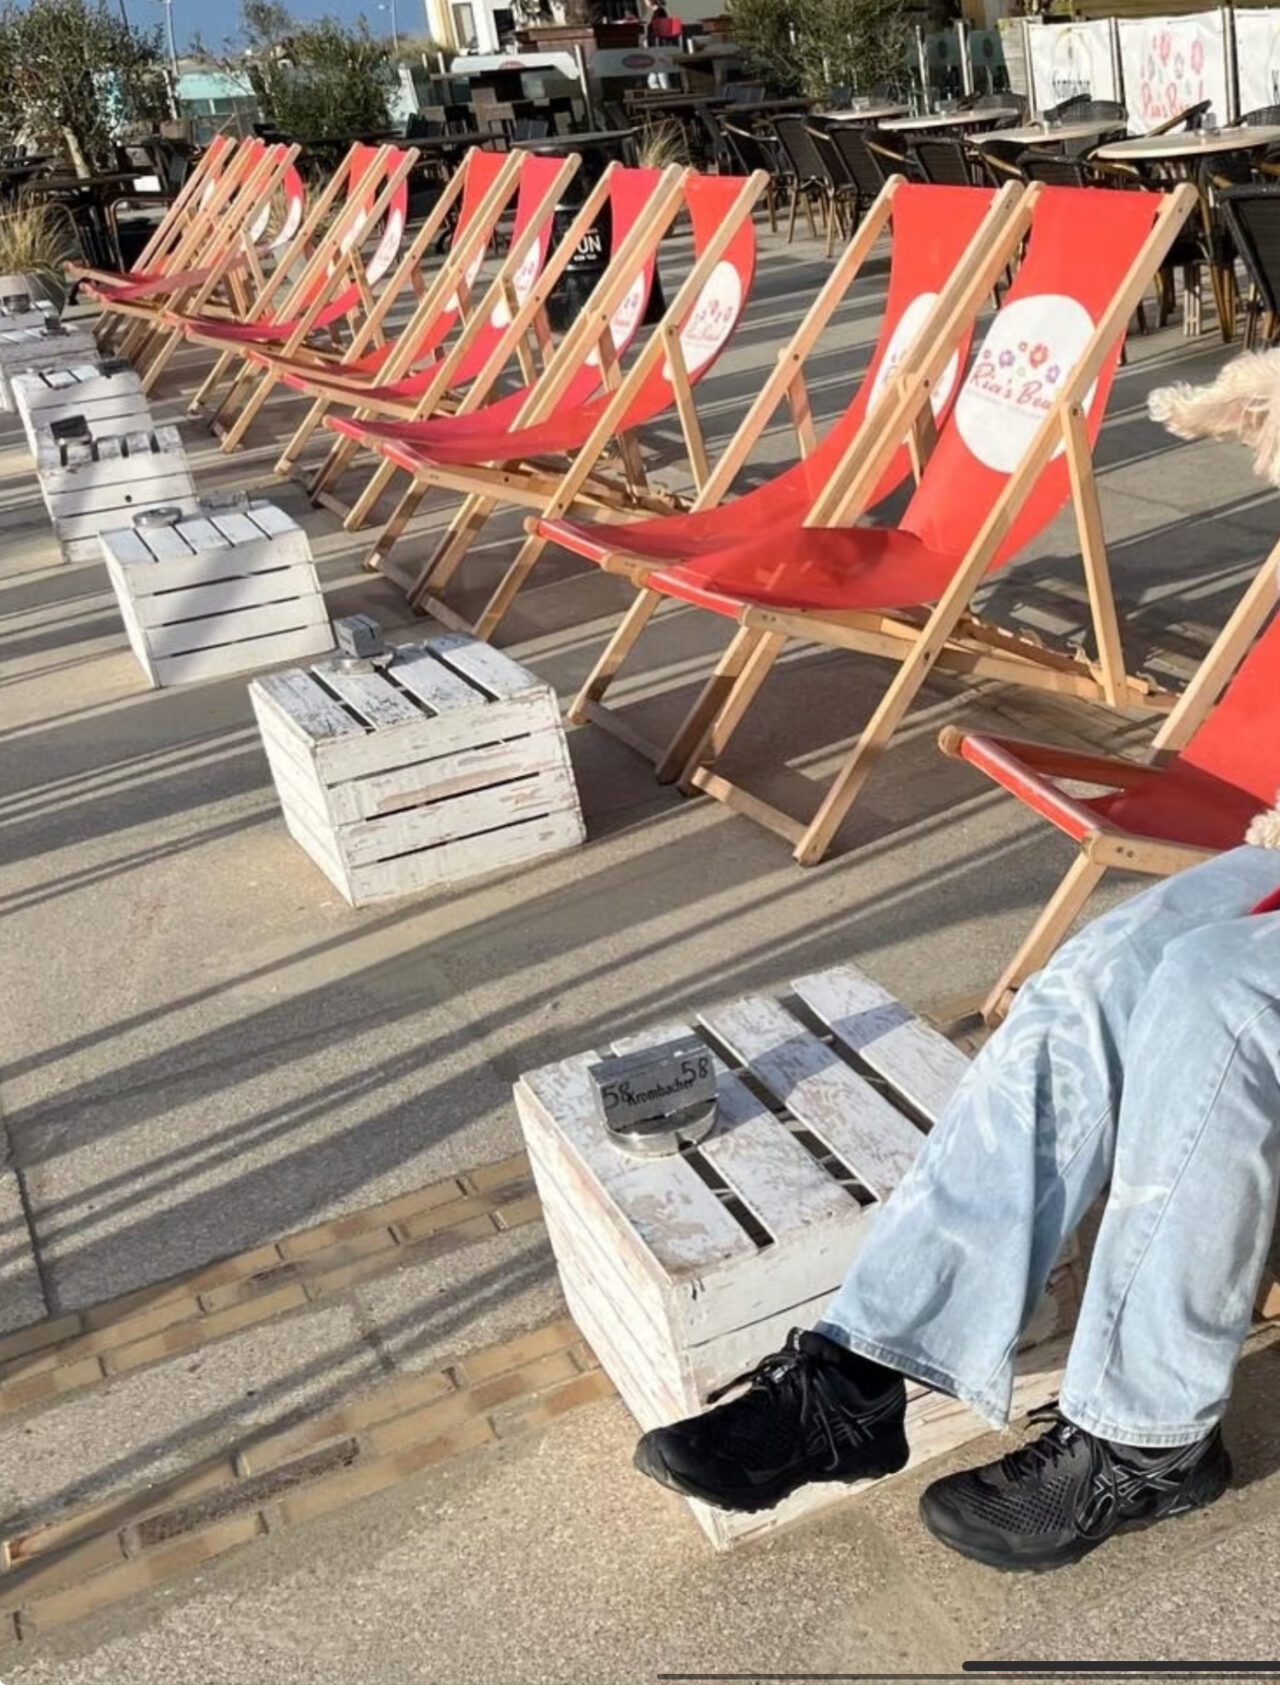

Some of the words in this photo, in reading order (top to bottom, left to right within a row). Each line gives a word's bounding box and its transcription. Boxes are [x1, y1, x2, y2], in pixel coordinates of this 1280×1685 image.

[576, 234, 602, 254] UN
[1016, 380, 1053, 410] Bea
[681, 1057, 709, 1082] 58
[627, 1077, 694, 1106] Krombacher
